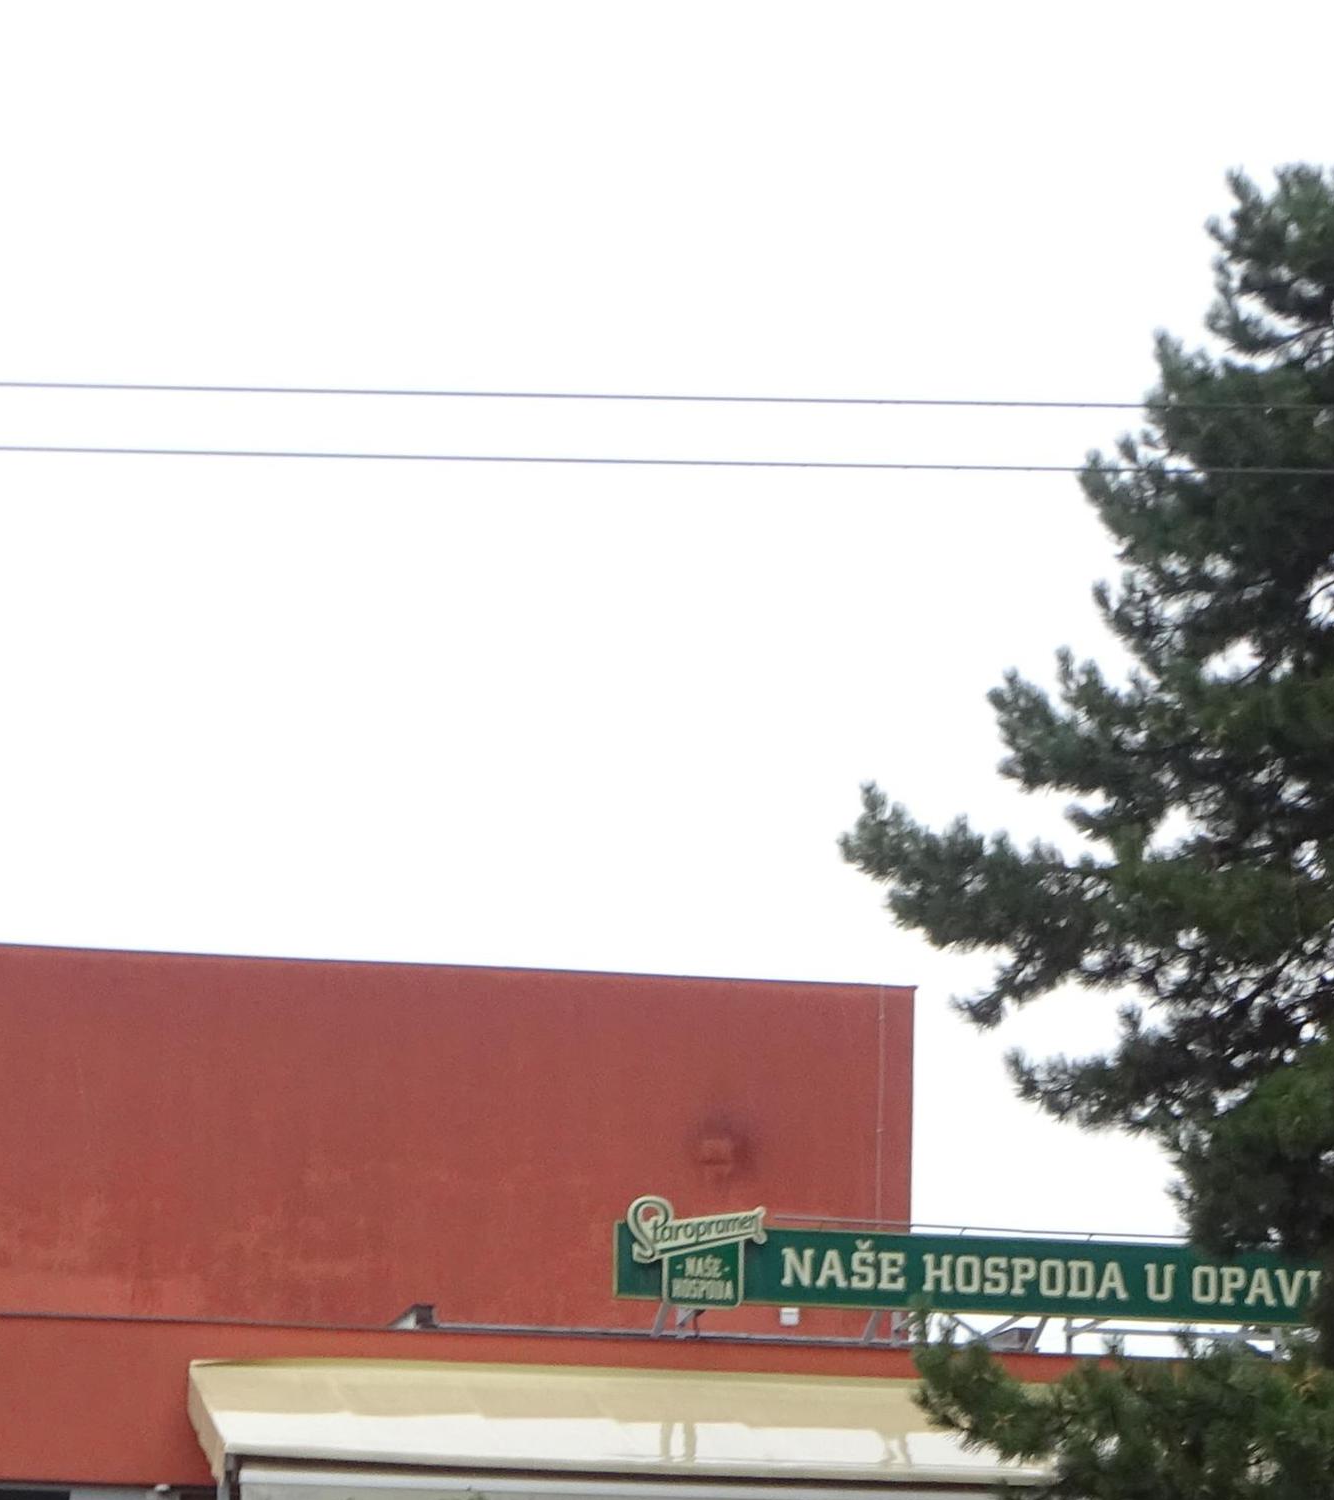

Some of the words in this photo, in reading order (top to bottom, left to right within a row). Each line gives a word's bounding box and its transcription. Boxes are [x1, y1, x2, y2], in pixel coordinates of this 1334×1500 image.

[630, 1197, 762, 1261] Staropramen
[781, 1238, 907, 1291] NAŠE
[921, 1253, 1129, 1301] HOSPODA
[1144, 1262, 1176, 1302] U
